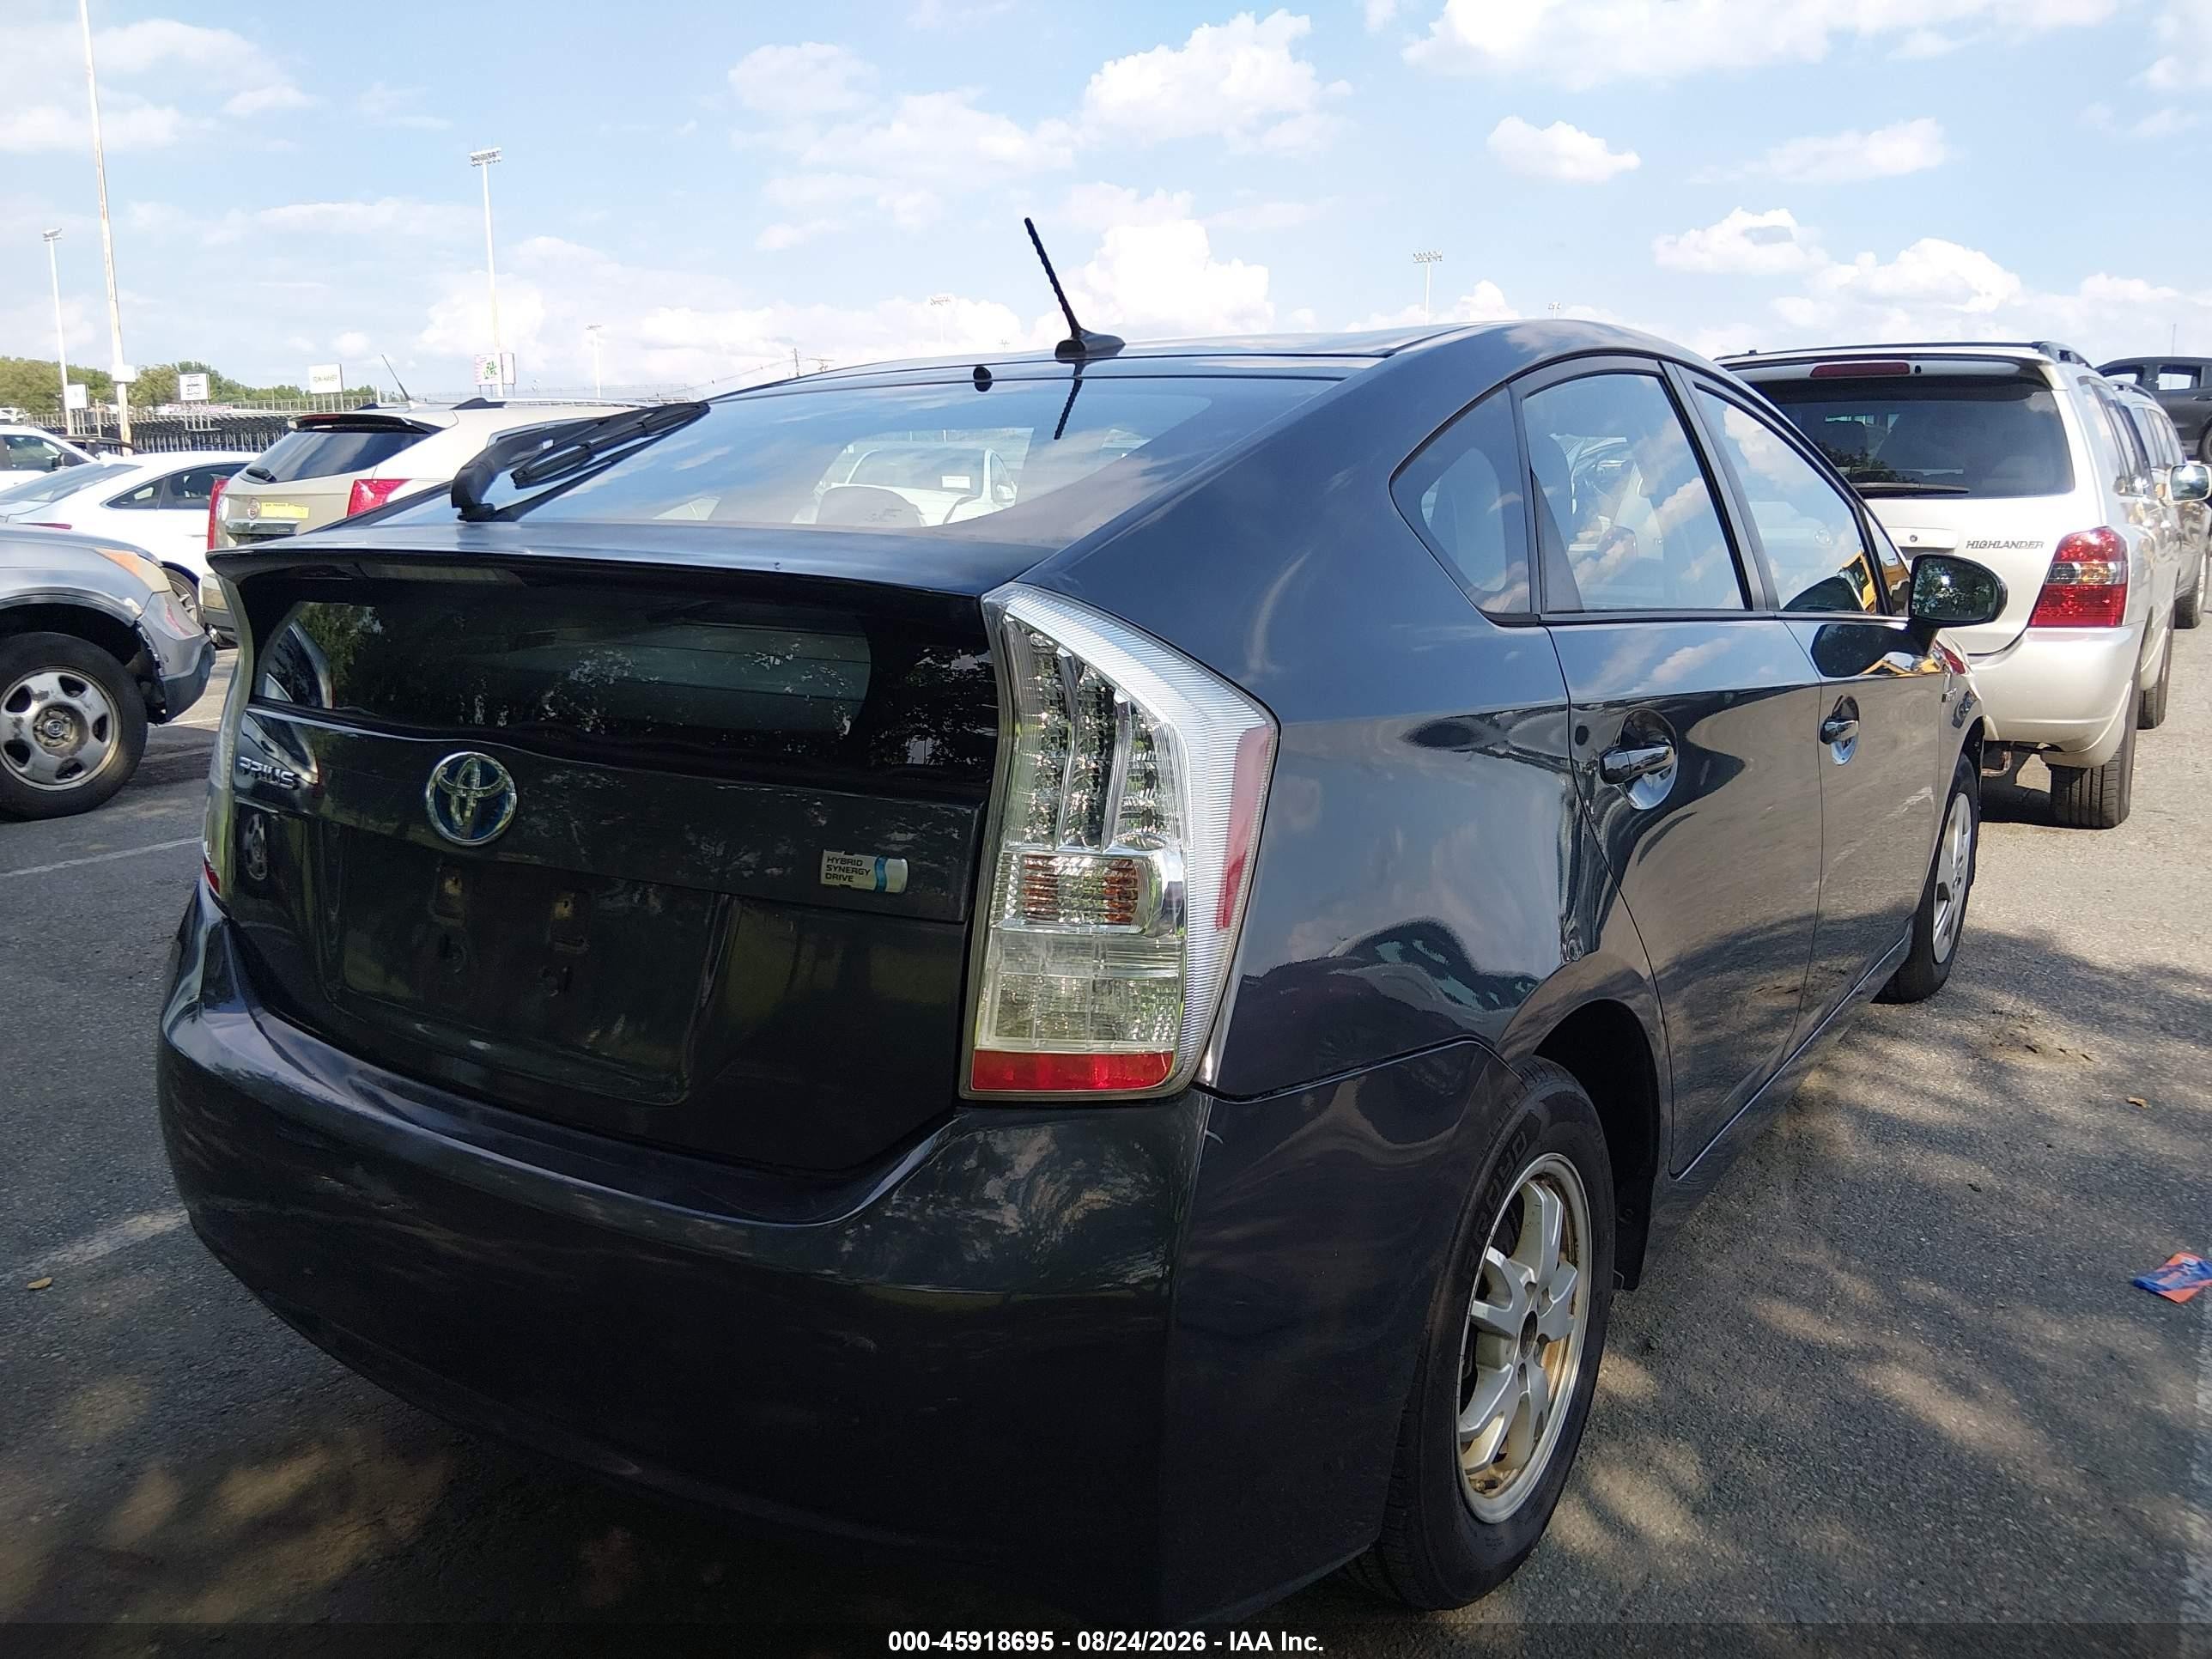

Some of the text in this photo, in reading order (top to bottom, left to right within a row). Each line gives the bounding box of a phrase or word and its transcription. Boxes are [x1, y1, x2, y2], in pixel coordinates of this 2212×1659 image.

[1966, 540, 2044, 549] HIGHLANDER
[827, 856, 863, 866] HYBRID
[826, 864, 871, 876] SYNERGY
[825, 872, 854, 882] DRIVE
